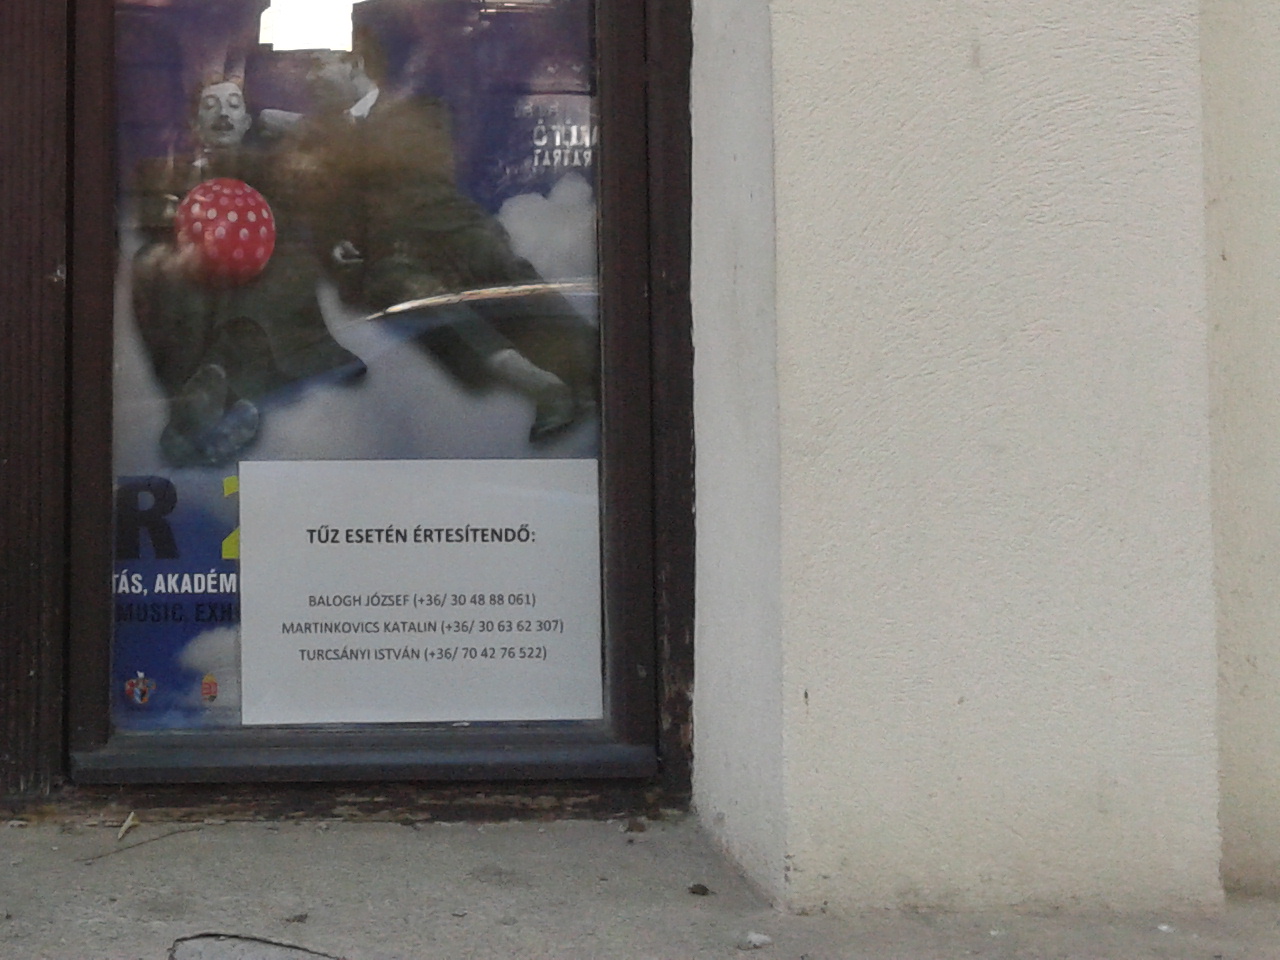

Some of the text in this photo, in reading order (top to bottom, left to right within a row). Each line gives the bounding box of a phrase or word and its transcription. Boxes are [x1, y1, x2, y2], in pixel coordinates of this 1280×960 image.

[306, 524, 536, 543] TŰZ ESETÉN ÉRTESÍTENDŐ:
[154, 569, 237, 593] AKADÉM
[308, 592, 536, 608] BALOGH JÓZSEF (+36/ 30 48 88 061)
[282, 619, 564, 635] MARTINKOVICS KATALIN (+36/ 30 63 62 307)
[299, 645, 547, 661] TURCSÁNYI ISTVÁN (+36/ 70 42 76 522)
